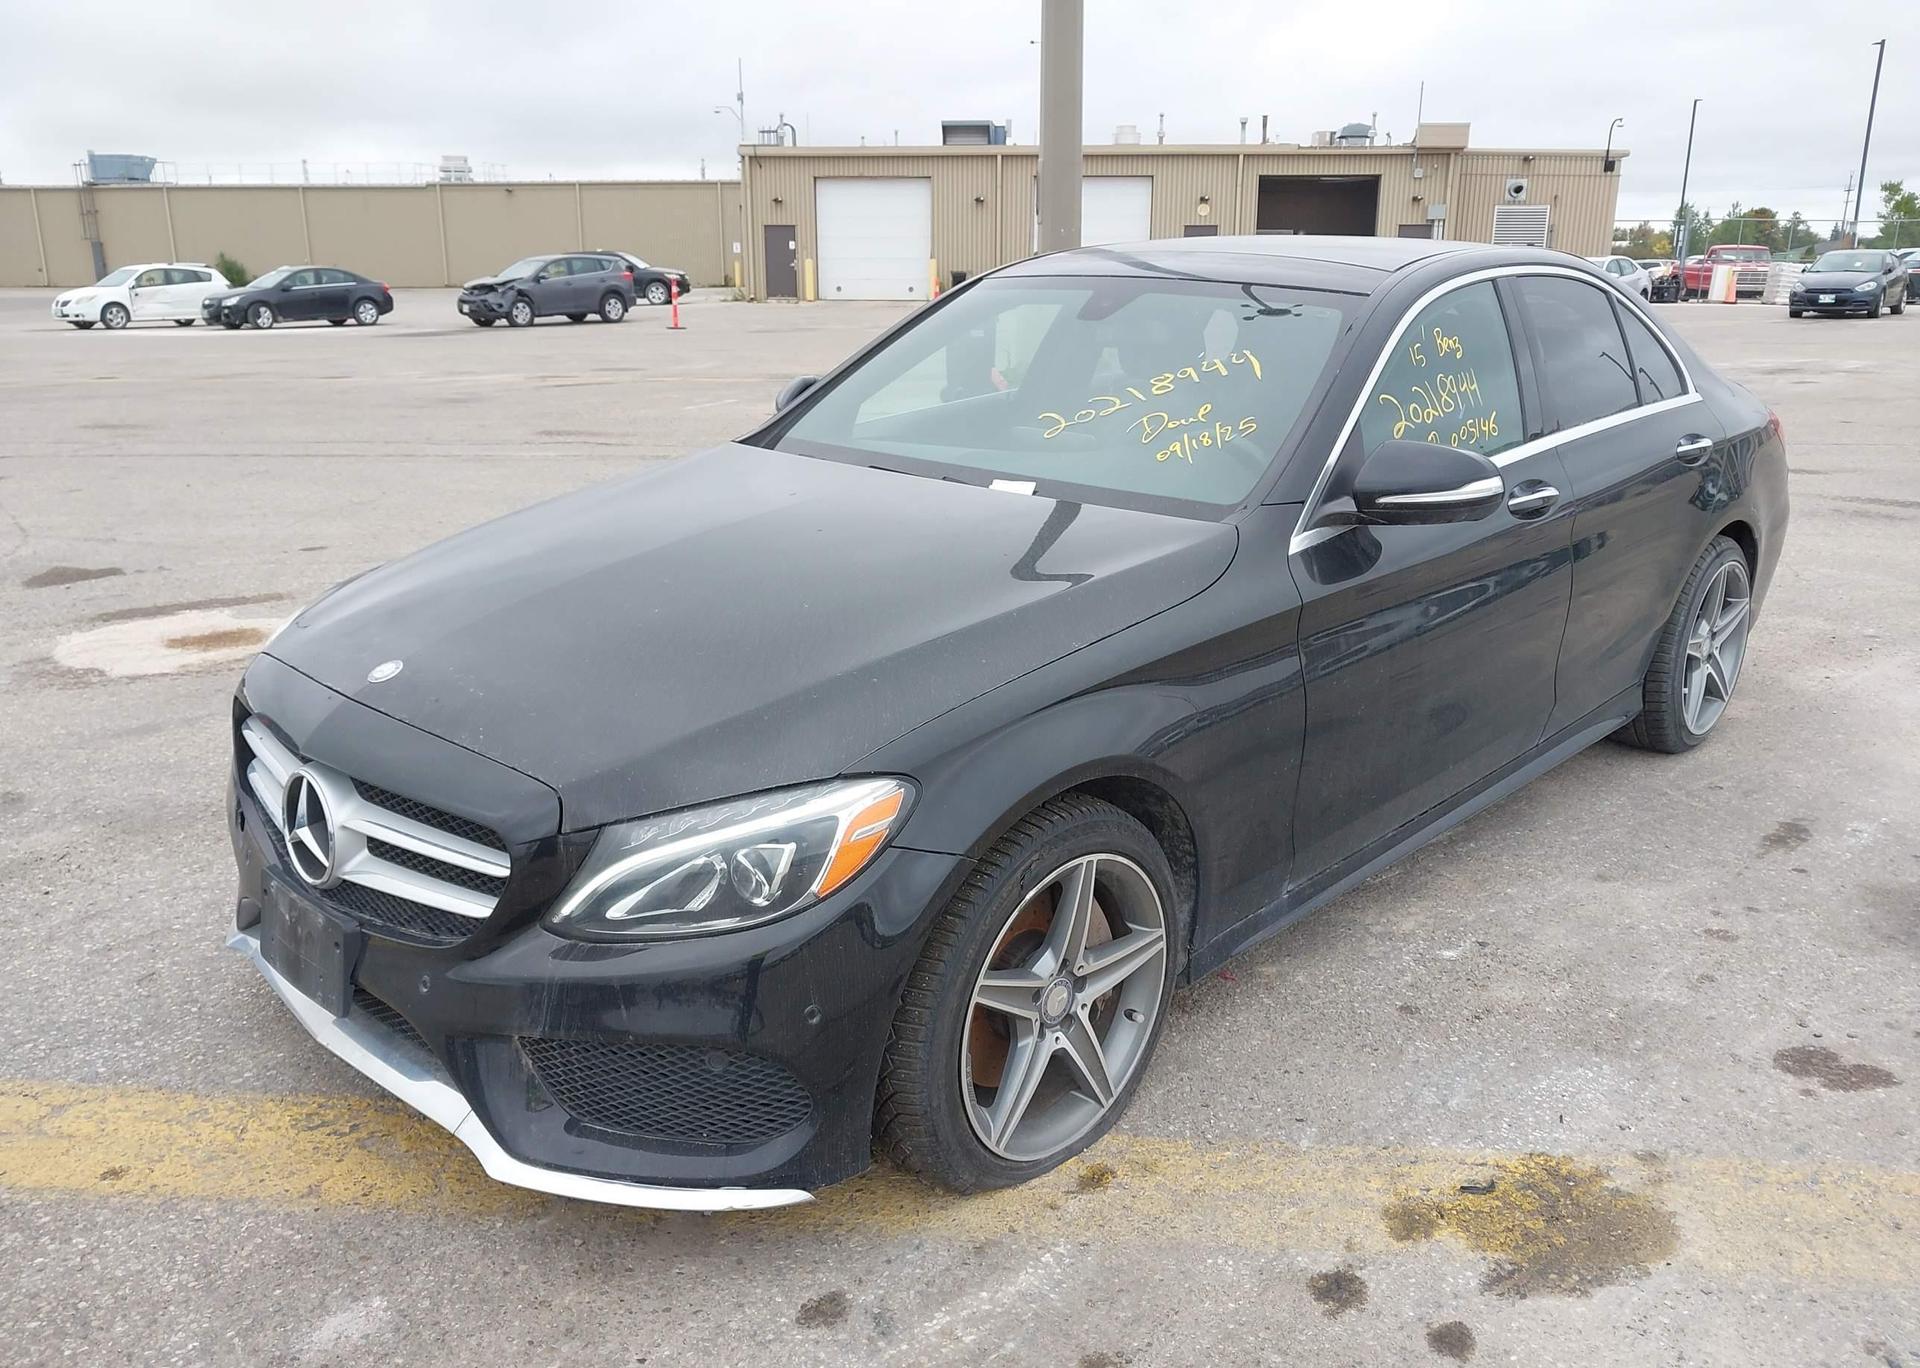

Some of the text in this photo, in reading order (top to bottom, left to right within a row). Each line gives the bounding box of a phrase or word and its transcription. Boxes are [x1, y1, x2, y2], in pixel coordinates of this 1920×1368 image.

[1433, 327, 1463, 359] Benz
[1038, 349, 1262, 439] 20218944
[1379, 367, 1484, 439] 20218944
[1156, 416, 1257, 464] 09/18/25
[1451, 410, 1499, 447] 005146
